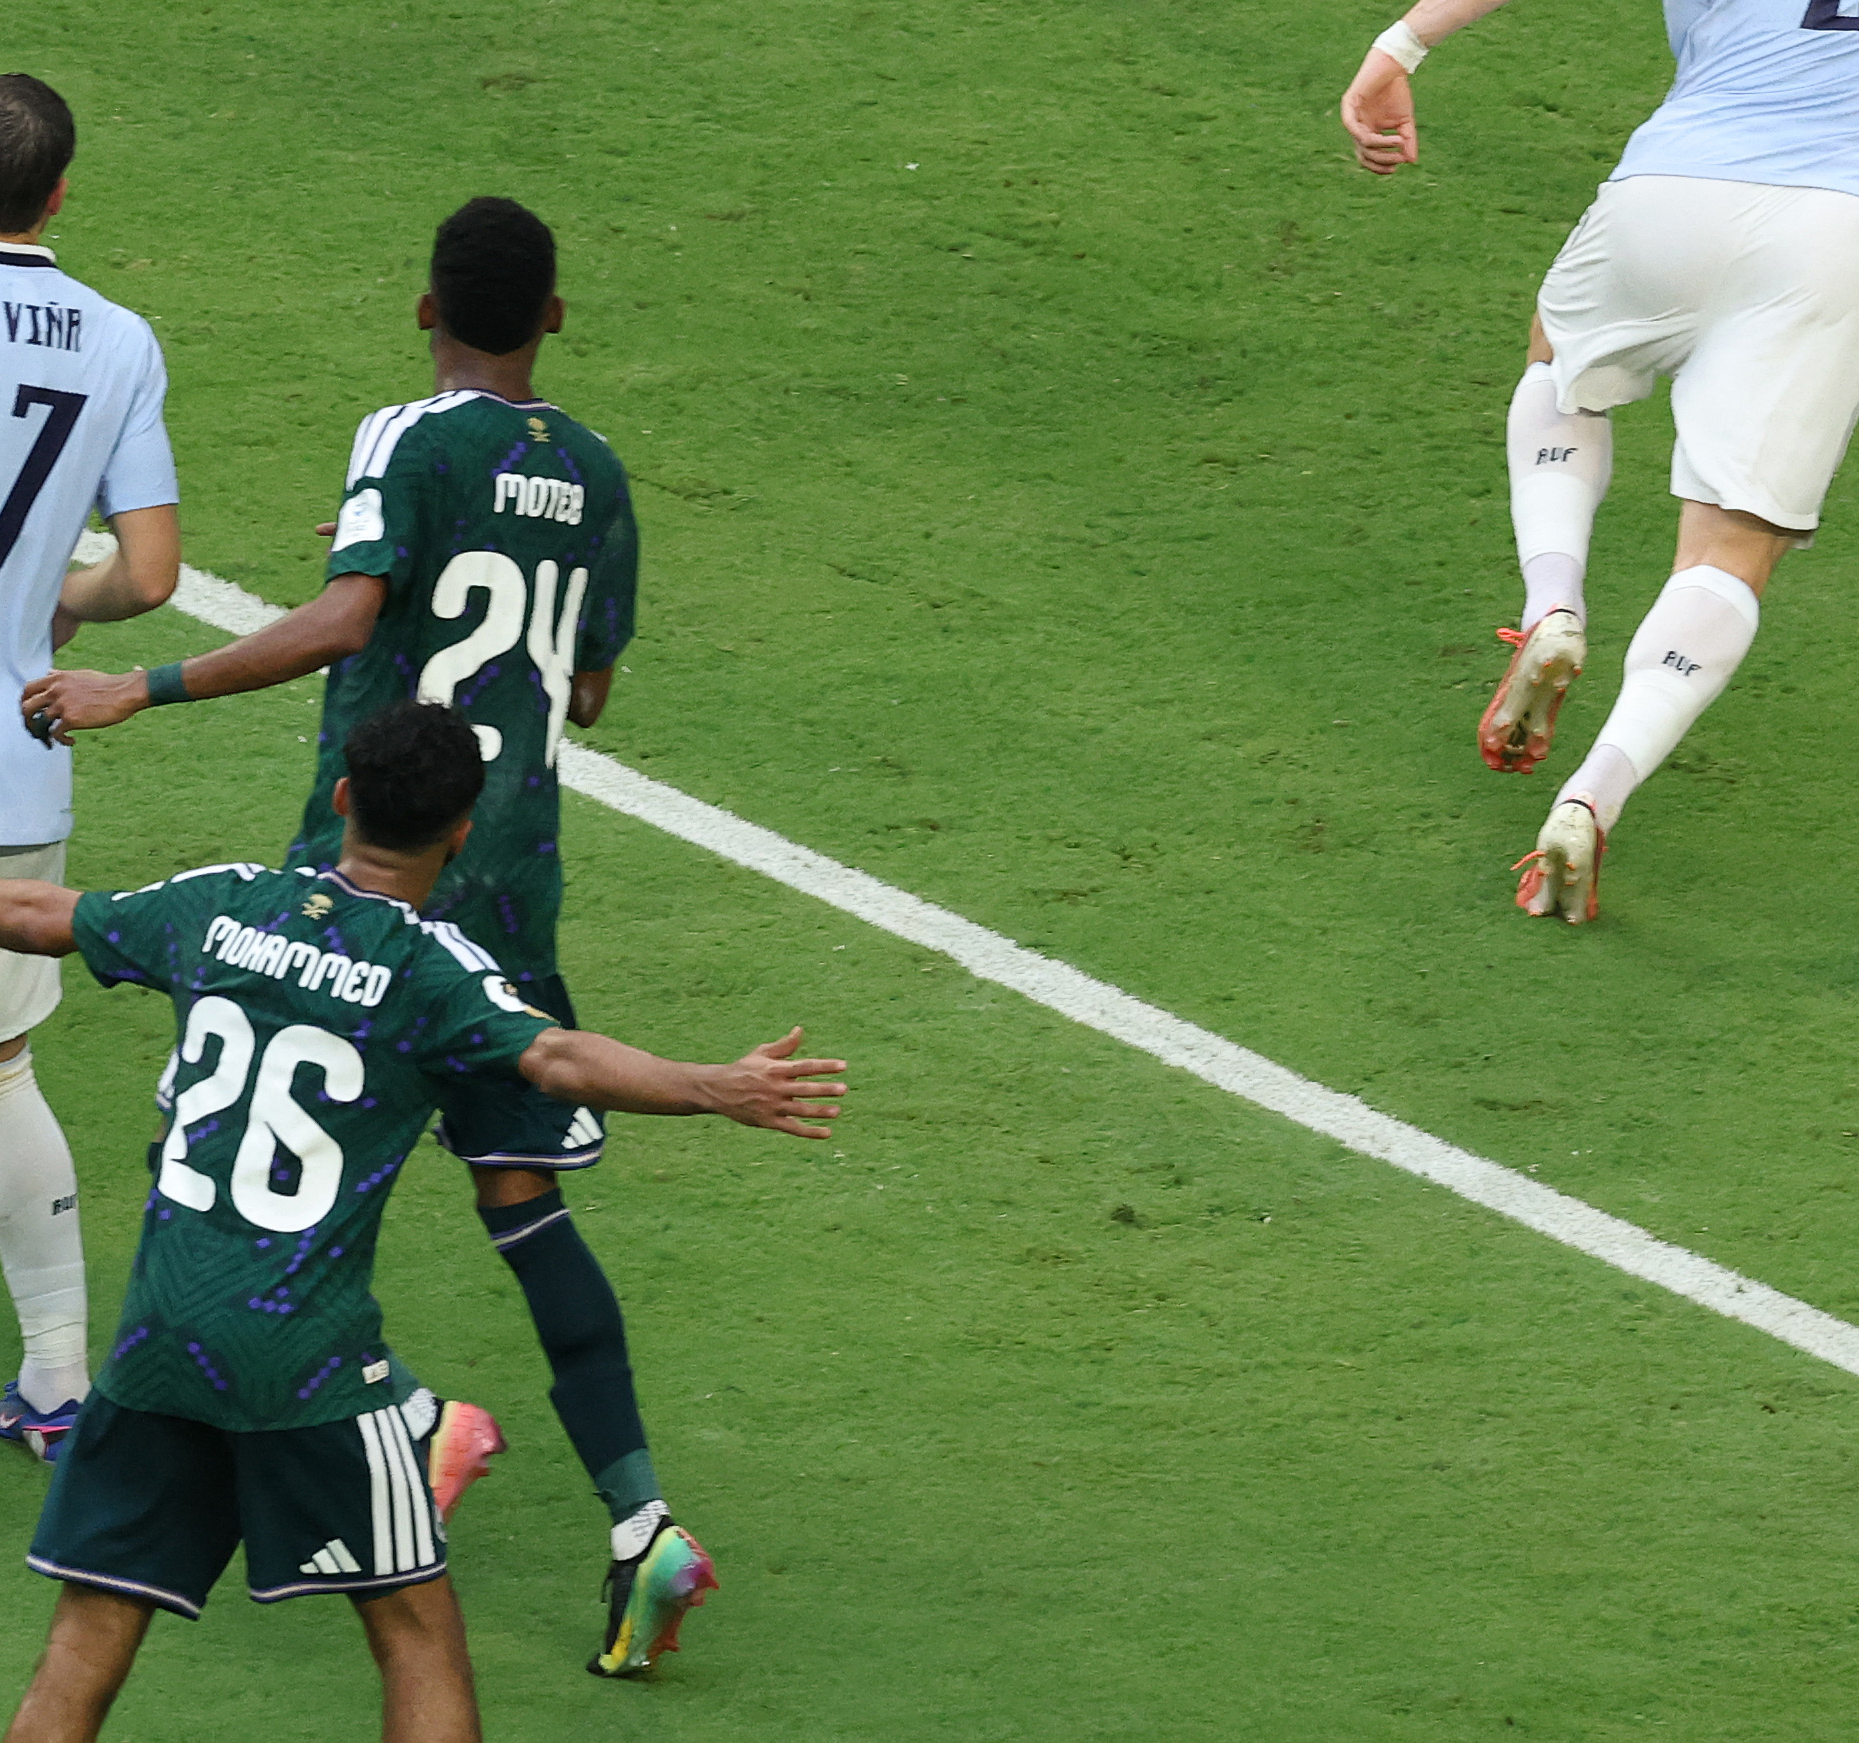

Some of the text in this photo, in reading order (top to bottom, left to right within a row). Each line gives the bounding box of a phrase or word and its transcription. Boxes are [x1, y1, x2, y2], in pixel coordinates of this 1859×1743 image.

[416, 550, 590, 769] 24
[201, 915, 393, 1008] MOHAMMED
[157, 994, 366, 1233] 26
